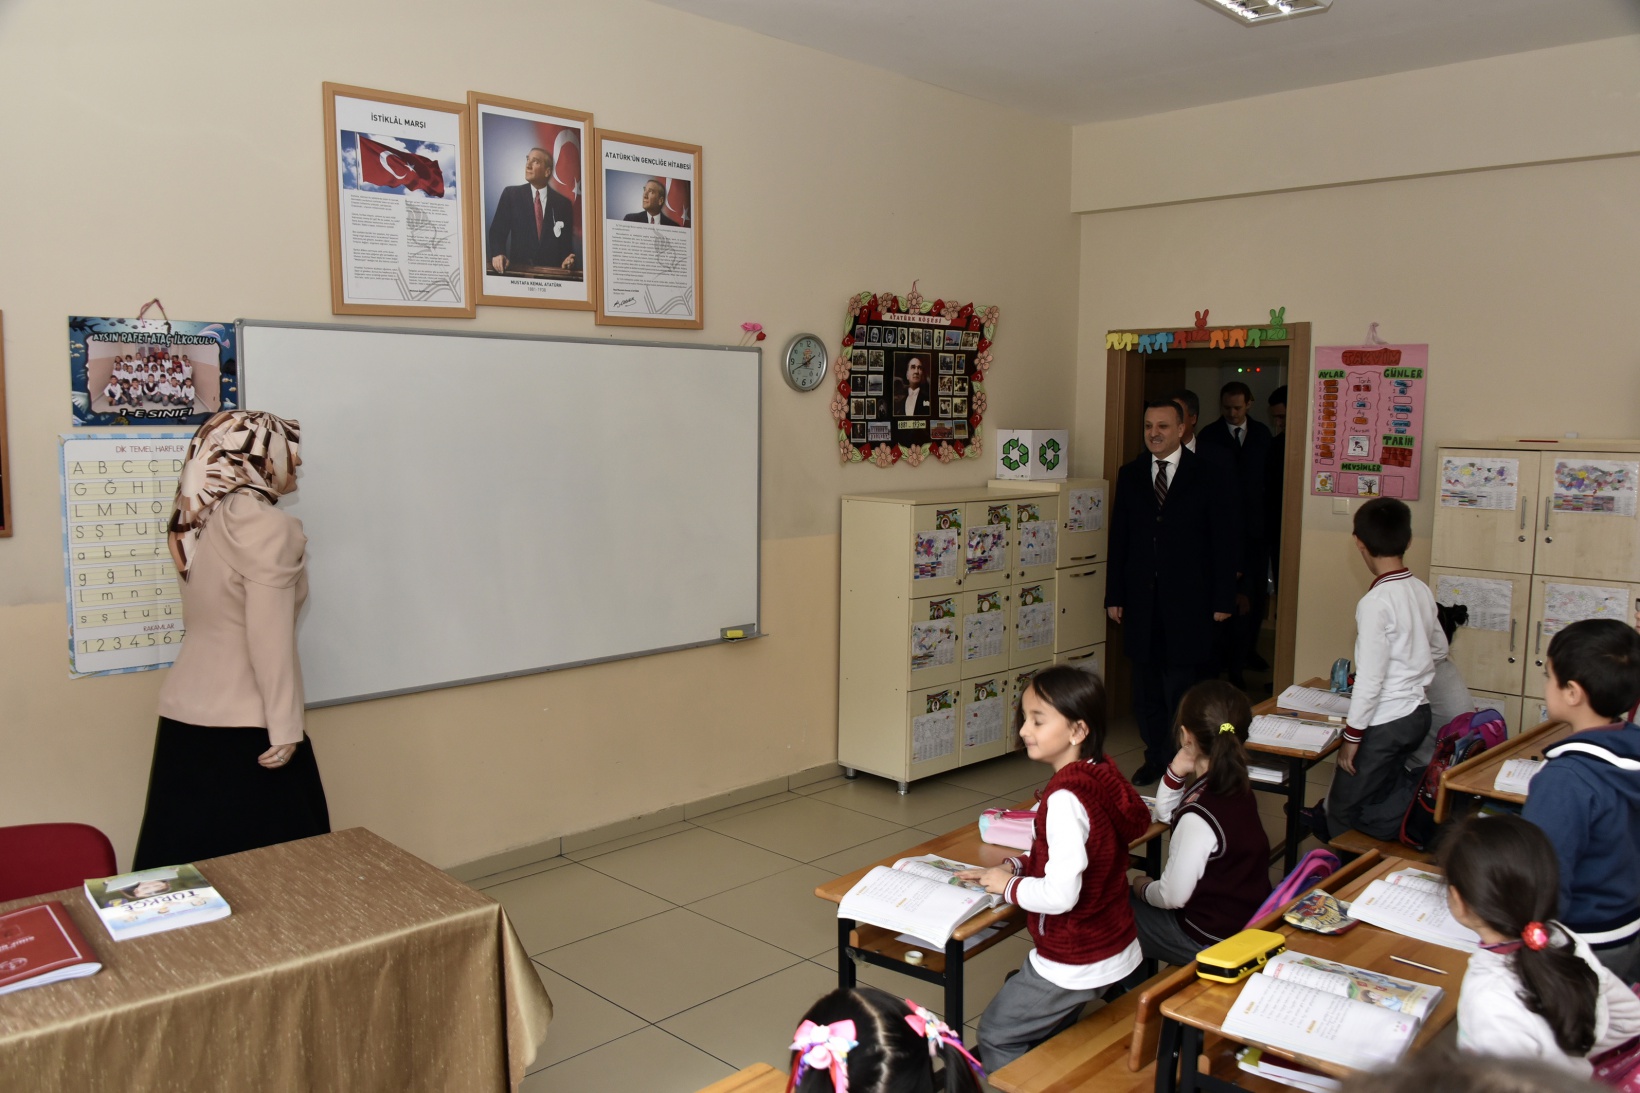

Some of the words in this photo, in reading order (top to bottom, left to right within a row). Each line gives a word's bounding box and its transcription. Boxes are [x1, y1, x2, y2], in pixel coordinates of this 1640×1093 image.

[371, 112, 402, 125] İSTİKLÂL
[404, 119, 426, 129] MARŞI
[605, 151, 640, 163] ATATÜRK'ÜN
[641, 157, 667, 166] GENÇLİĞE
[668, 161, 691, 170] HİTABESİ
[889, 314, 916, 322] ATATÜRK
[121, 332, 149, 344] RAFET
[151, 332, 171, 347] ATAÇ
[173, 331, 217, 345] İLKOKULU
[1343, 349, 1400, 365] TAKVİM
[1318, 370, 1345, 378] AYLAR
[1383, 367, 1423, 379] GÜNLER
[147, 408, 193, 418] SINIFI
[1383, 435, 1413, 446] TARİH
[115, 445, 127, 453] DİK
[129, 445, 154, 453] TEMEL
[155, 445, 185, 453] HARFLER
[73, 461, 84, 475] A
[98, 460, 108, 474] B
[122, 460, 133, 473] C
[148, 459, 159, 476] Ç
[172, 459, 183, 473] D
[1341, 462, 1382, 472] MEVSİMLER
[74, 482, 87, 496] G
[104, 479, 117, 495] Ğ
[132, 481, 144, 494] H
[75, 504, 84, 518] L
[97, 503, 112, 516] M
[126, 502, 137, 515] N
[151, 501, 163, 514] O
[76, 525, 85, 539] S
[95, 524, 104, 540] Ş
[114, 523, 124, 537] T
[136, 522, 148, 535] U
[157, 518, 168, 534] Ü
[77, 552, 85, 560] a
[103, 545, 112, 559] b
[130, 548, 137, 557] c
[153, 547, 160, 558] ç
[78, 573, 87, 586] g
[106, 569, 114, 584] ğ
[134, 564, 142, 577] h
[161, 564, 164, 575] i
[102, 592, 114, 600] m
[131, 589, 139, 598] n
[155, 587, 163, 596] o
[81, 615, 87, 624] s
[101, 613, 108, 624] ş
[122, 609, 127, 619] t
[142, 609, 150, 618] u
[164, 605, 172, 616] ü
[143, 623, 175, 632] RAKAMLAR
[82, 640, 88, 653] 1
[96, 639, 105, 652] 2
[113, 636, 122, 650] 3
[130, 635, 139, 648] 4
[147, 633, 156, 646] 5
[163, 631, 172, 644] 6
[179, 630, 187, 643] 7
